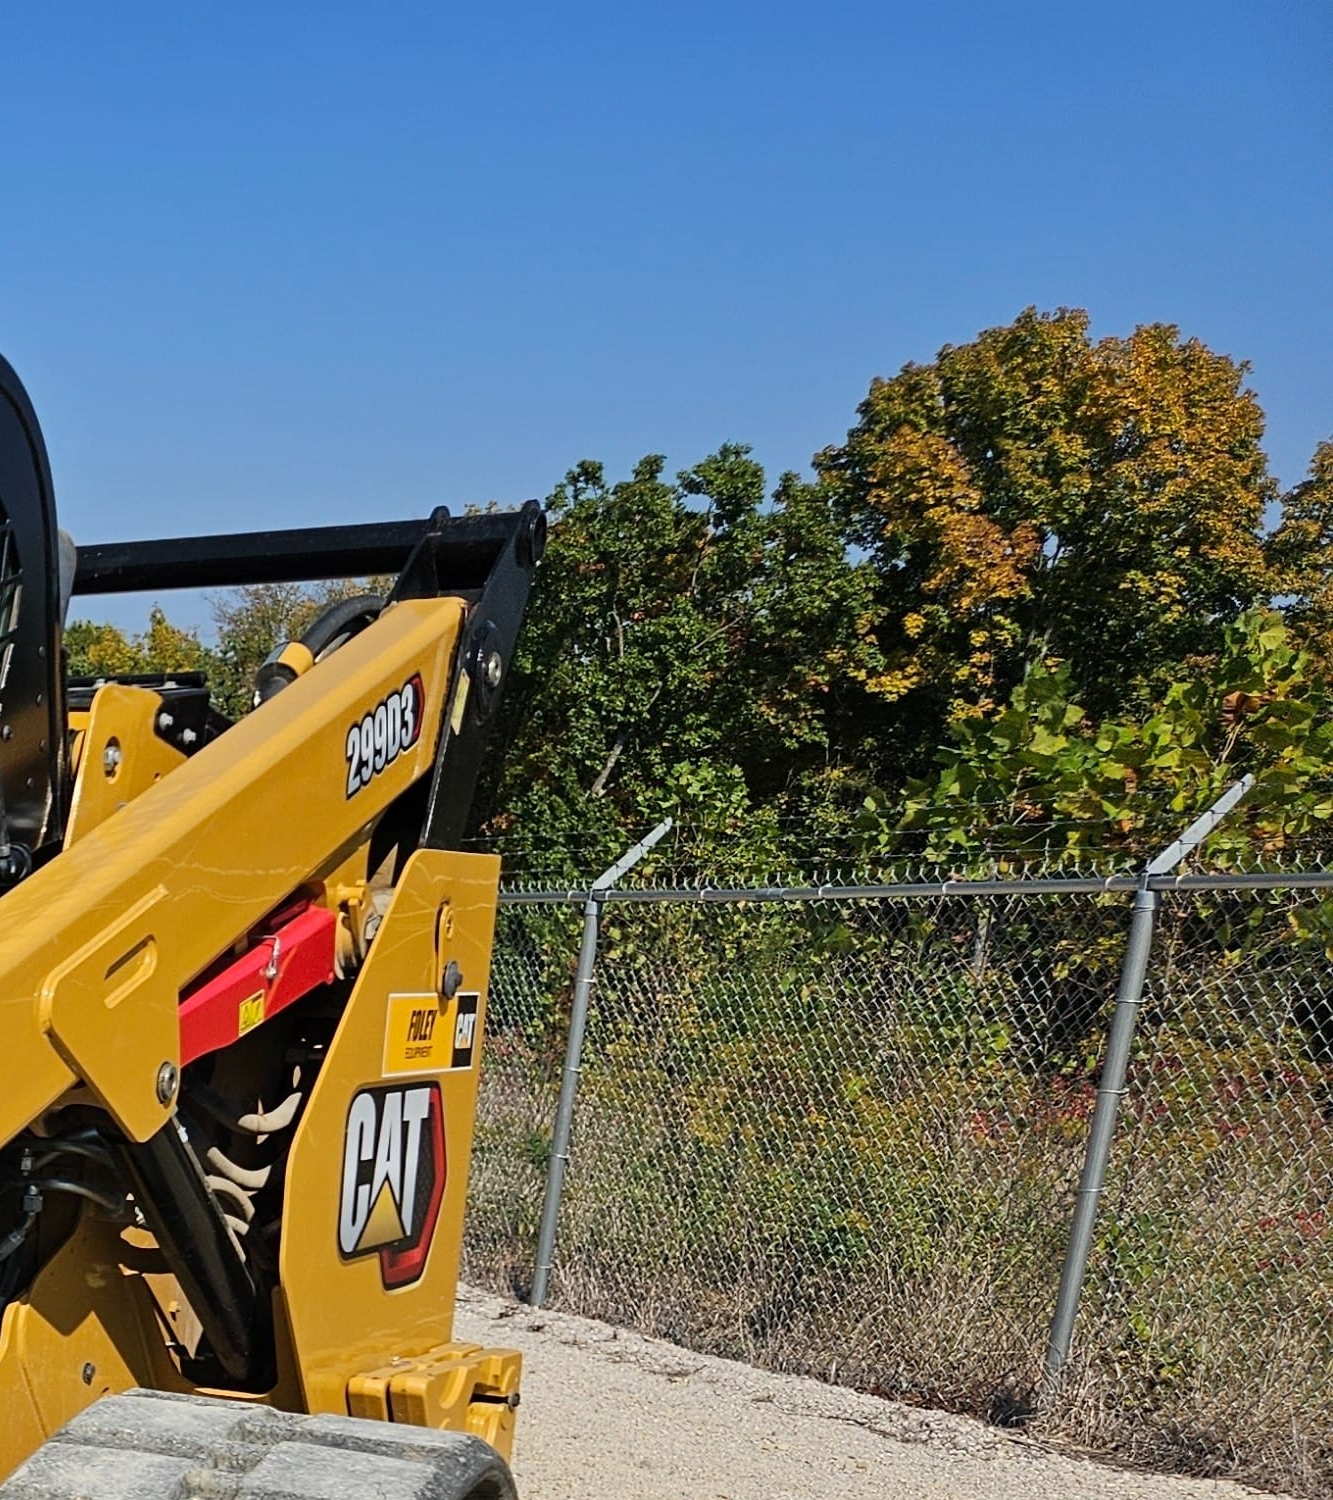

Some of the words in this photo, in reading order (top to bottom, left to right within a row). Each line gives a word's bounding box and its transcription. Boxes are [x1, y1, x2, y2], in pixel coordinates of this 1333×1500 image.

[347, 683, 415, 796] 299D3
[407, 1010, 438, 1041] FOLEY
[455, 1013, 476, 1049] CAT
[339, 1087, 431, 1254] CAT
